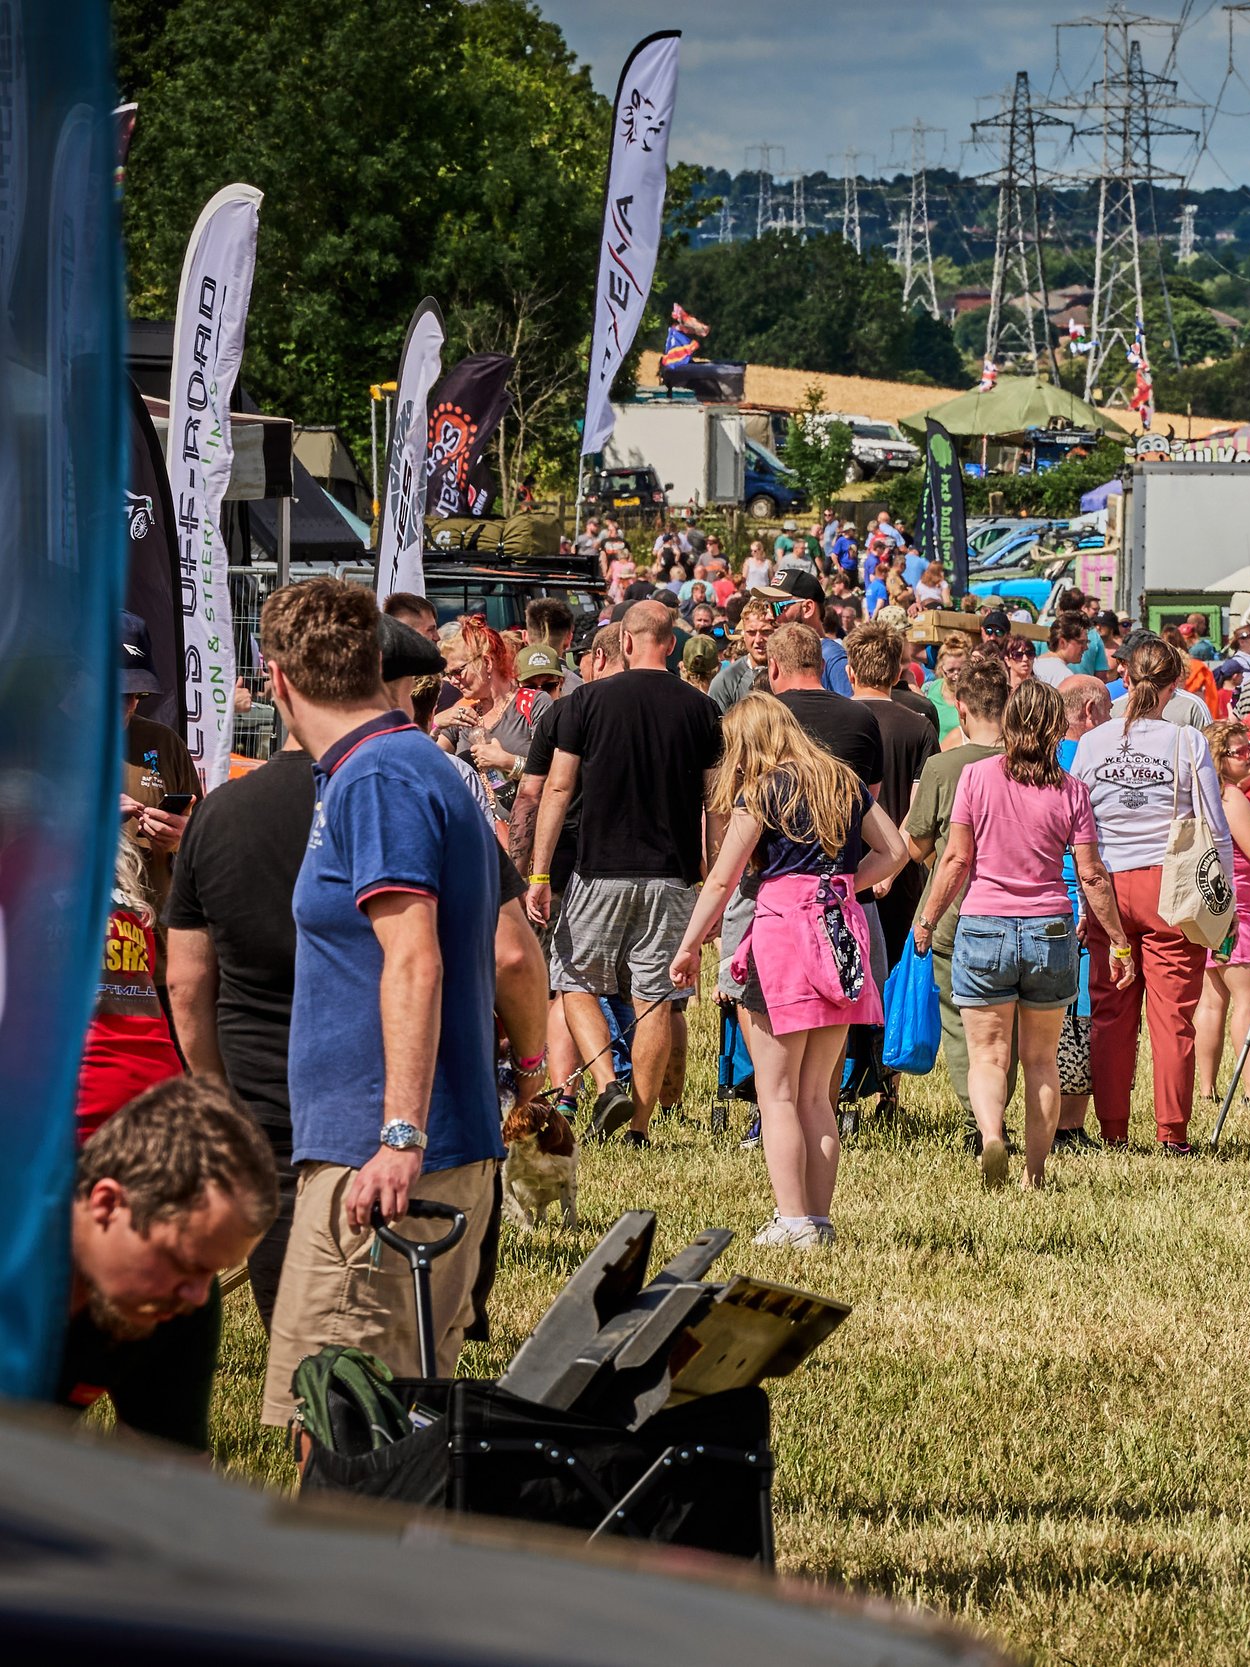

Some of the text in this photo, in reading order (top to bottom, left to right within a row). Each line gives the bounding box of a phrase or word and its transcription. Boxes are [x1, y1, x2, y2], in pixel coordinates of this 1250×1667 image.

[1105, 756, 1169, 767] WELCOME
[1105, 769, 1164, 781] LAS VEGAS
